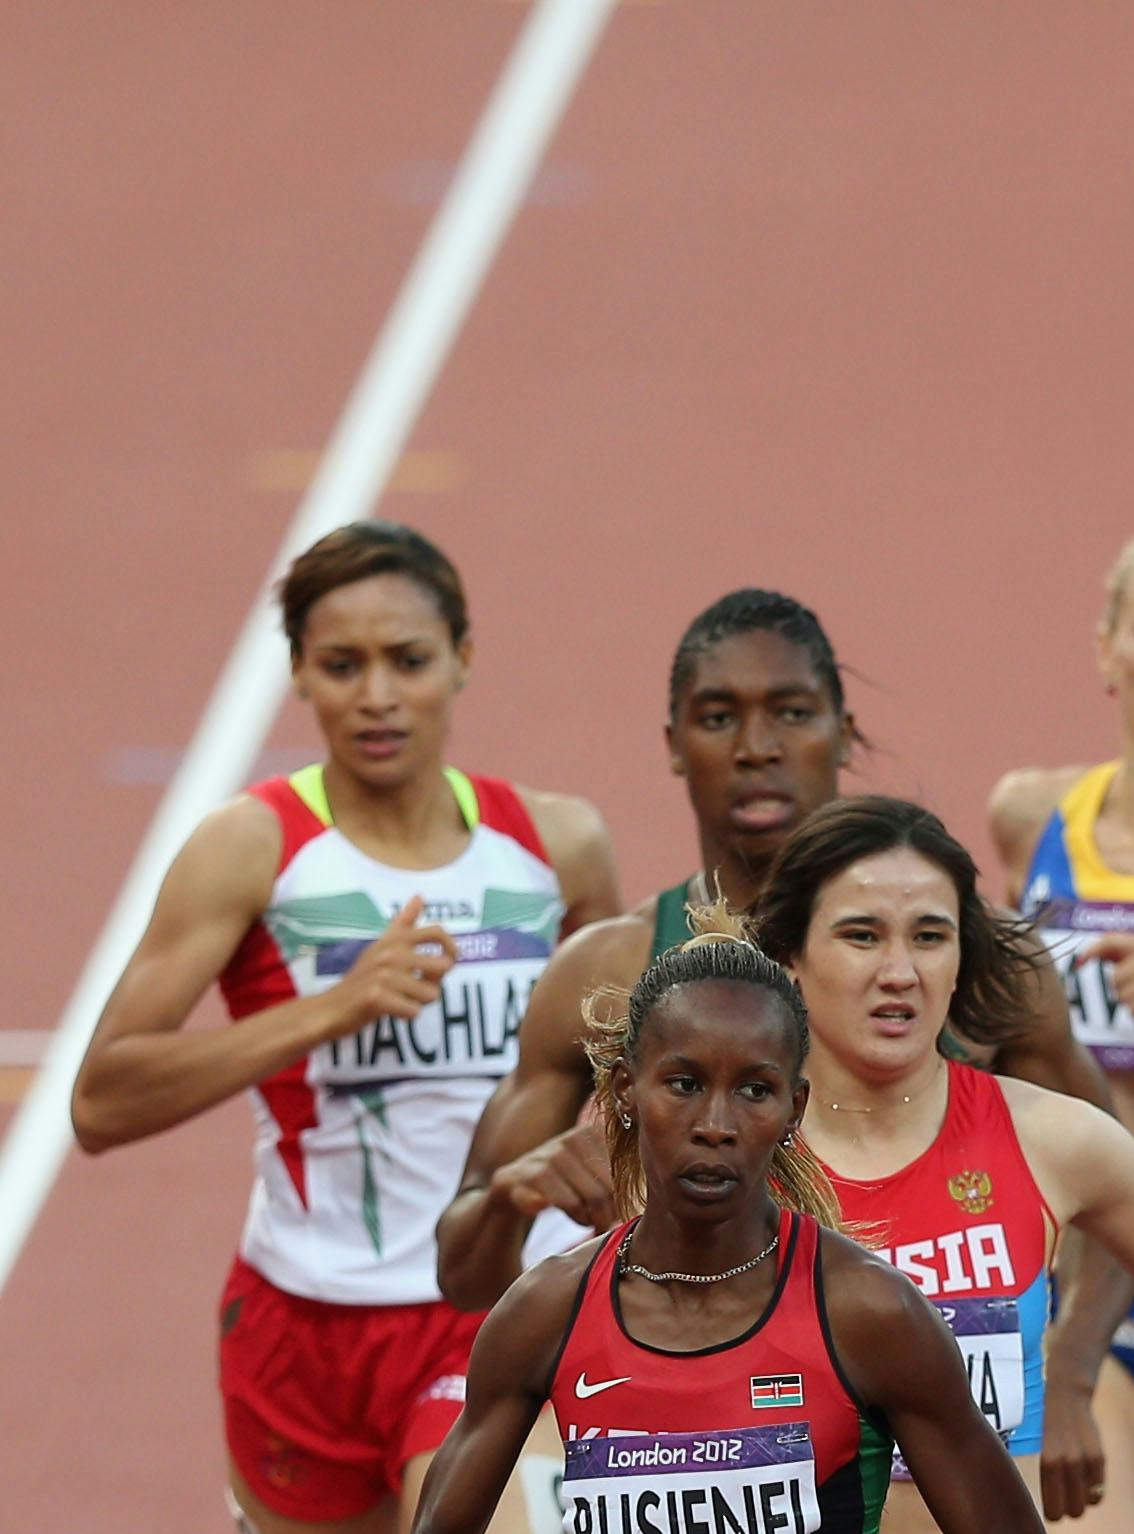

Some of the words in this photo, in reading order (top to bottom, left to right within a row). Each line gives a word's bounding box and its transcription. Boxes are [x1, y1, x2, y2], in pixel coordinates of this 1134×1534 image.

[329, 978, 537, 1066] ACHLA
[874, 1223, 1017, 1296] SIA
[607, 1443, 687, 1468] London
[692, 1439, 743, 1463] 2012
